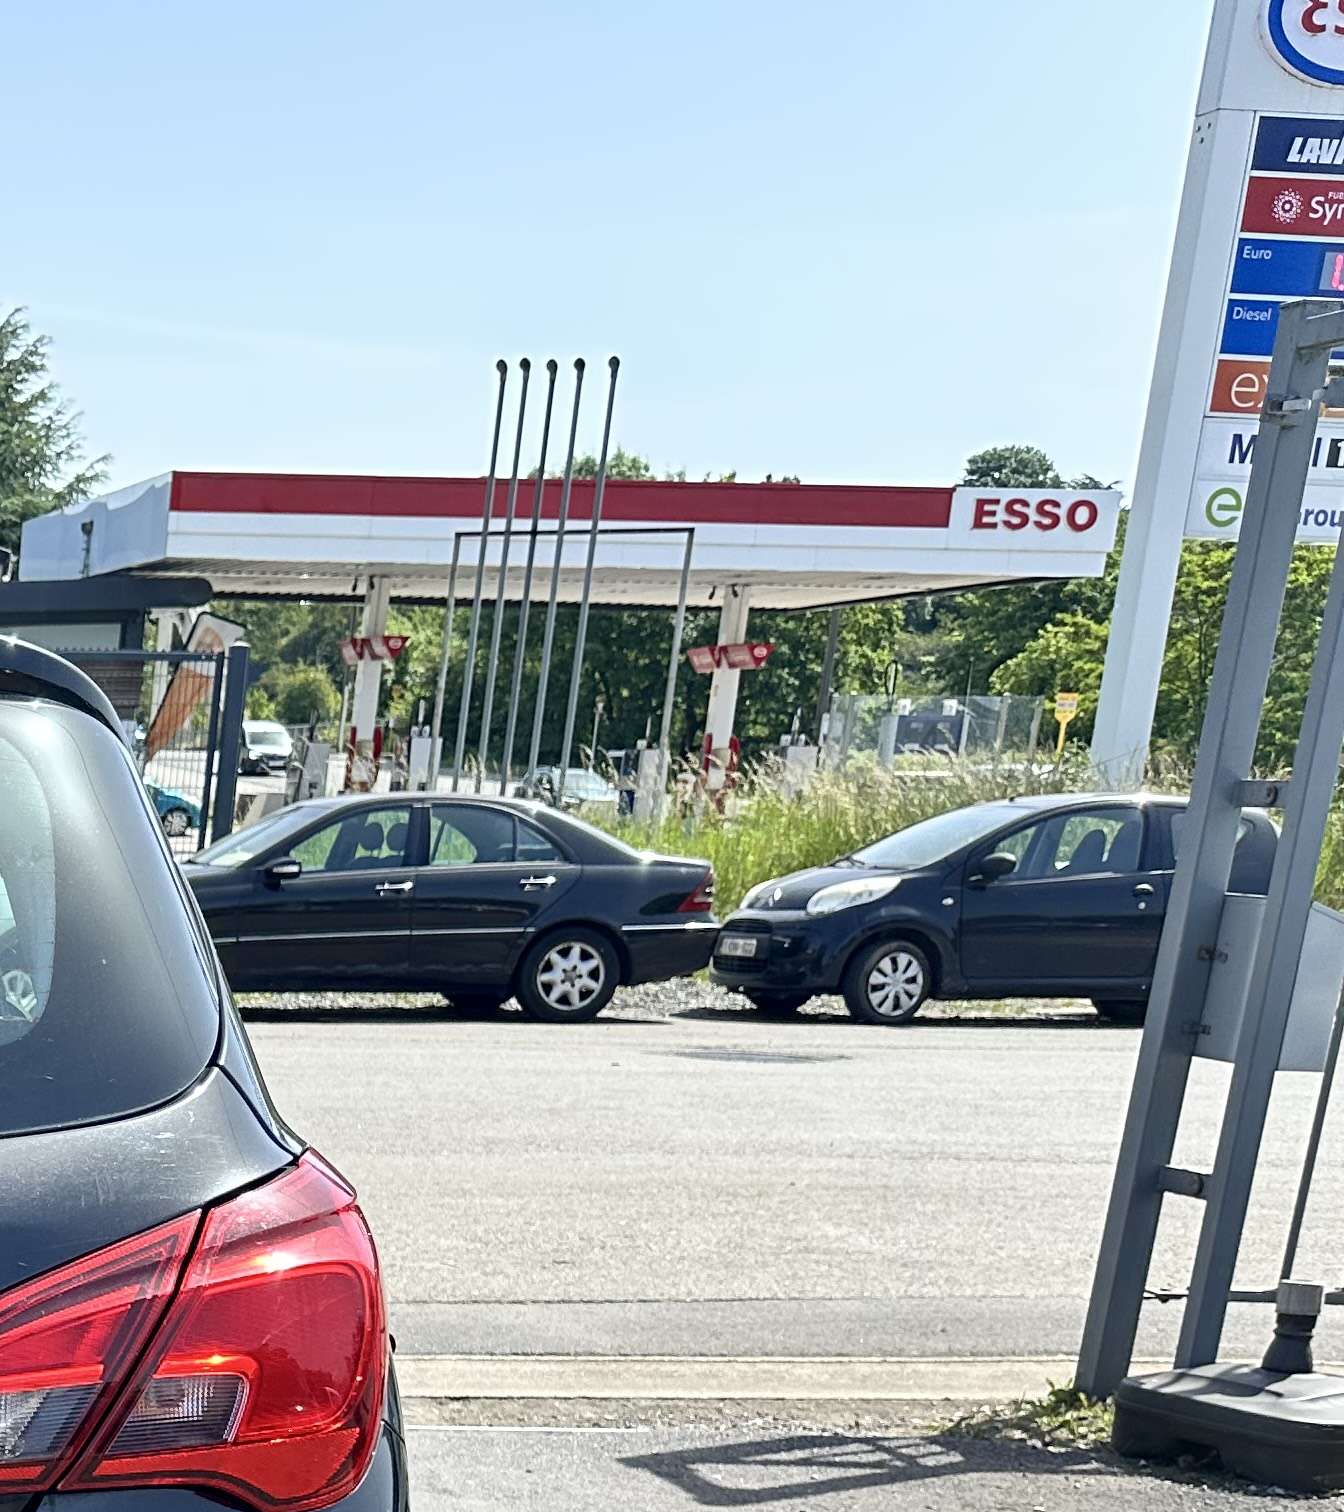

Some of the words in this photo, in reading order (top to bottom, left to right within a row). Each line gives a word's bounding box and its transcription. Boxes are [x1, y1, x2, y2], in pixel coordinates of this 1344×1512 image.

[1242, 246, 1272, 260] Euro
[1232, 306, 1272, 321] Diesel
[971, 498, 1098, 533] ESSO
